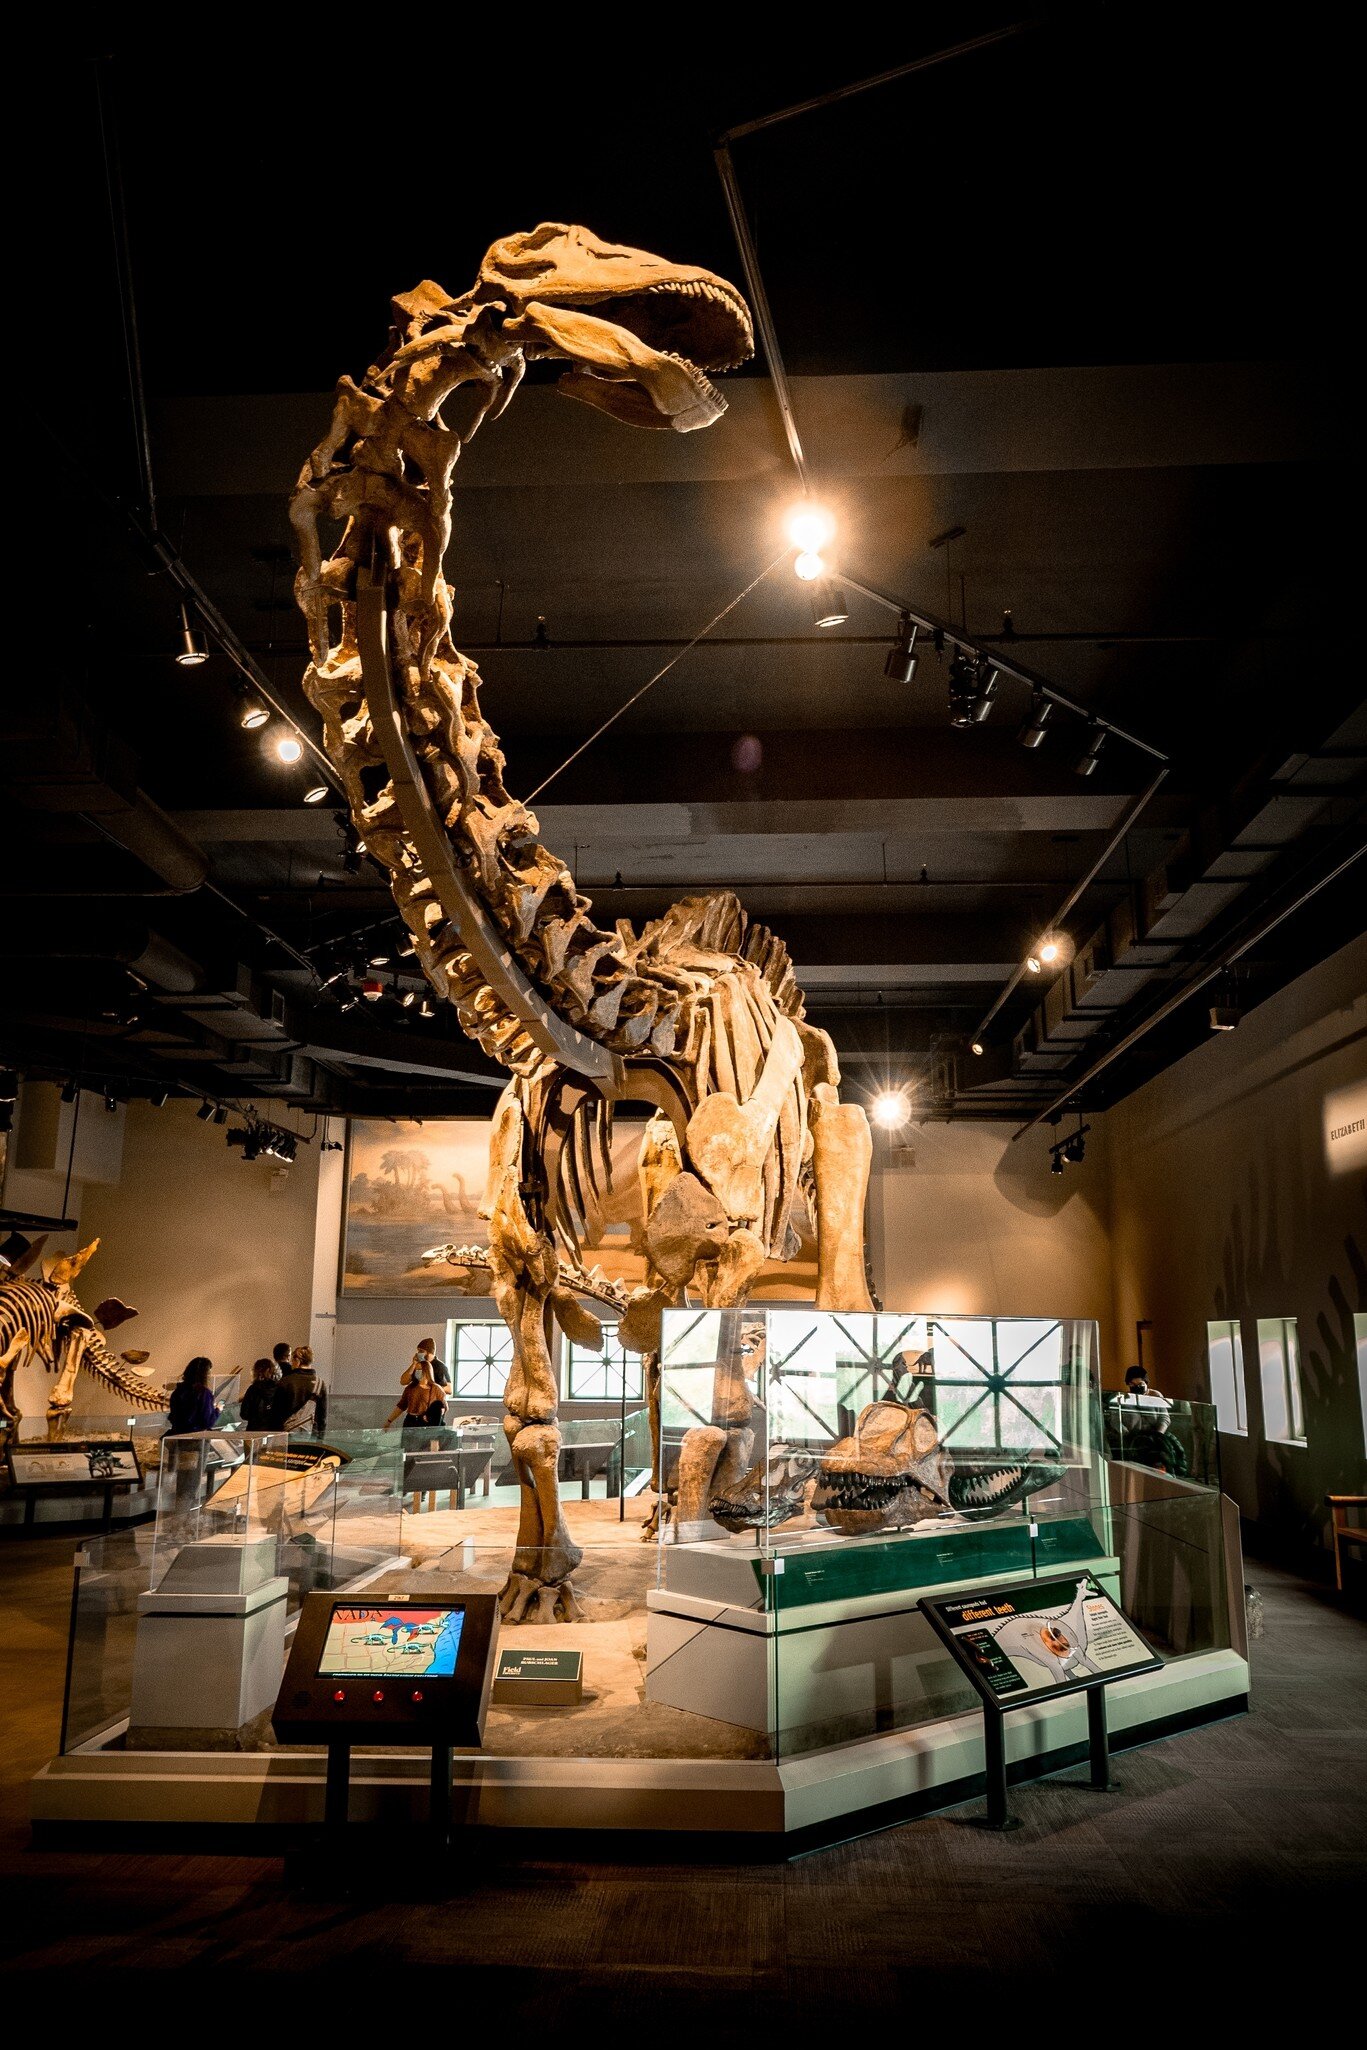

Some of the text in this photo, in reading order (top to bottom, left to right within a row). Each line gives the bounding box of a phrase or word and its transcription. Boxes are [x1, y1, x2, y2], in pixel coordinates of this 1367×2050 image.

[1331, 1119, 1365, 1140] ELIZABETH
[961, 1602, 1016, 1621] different teeth
